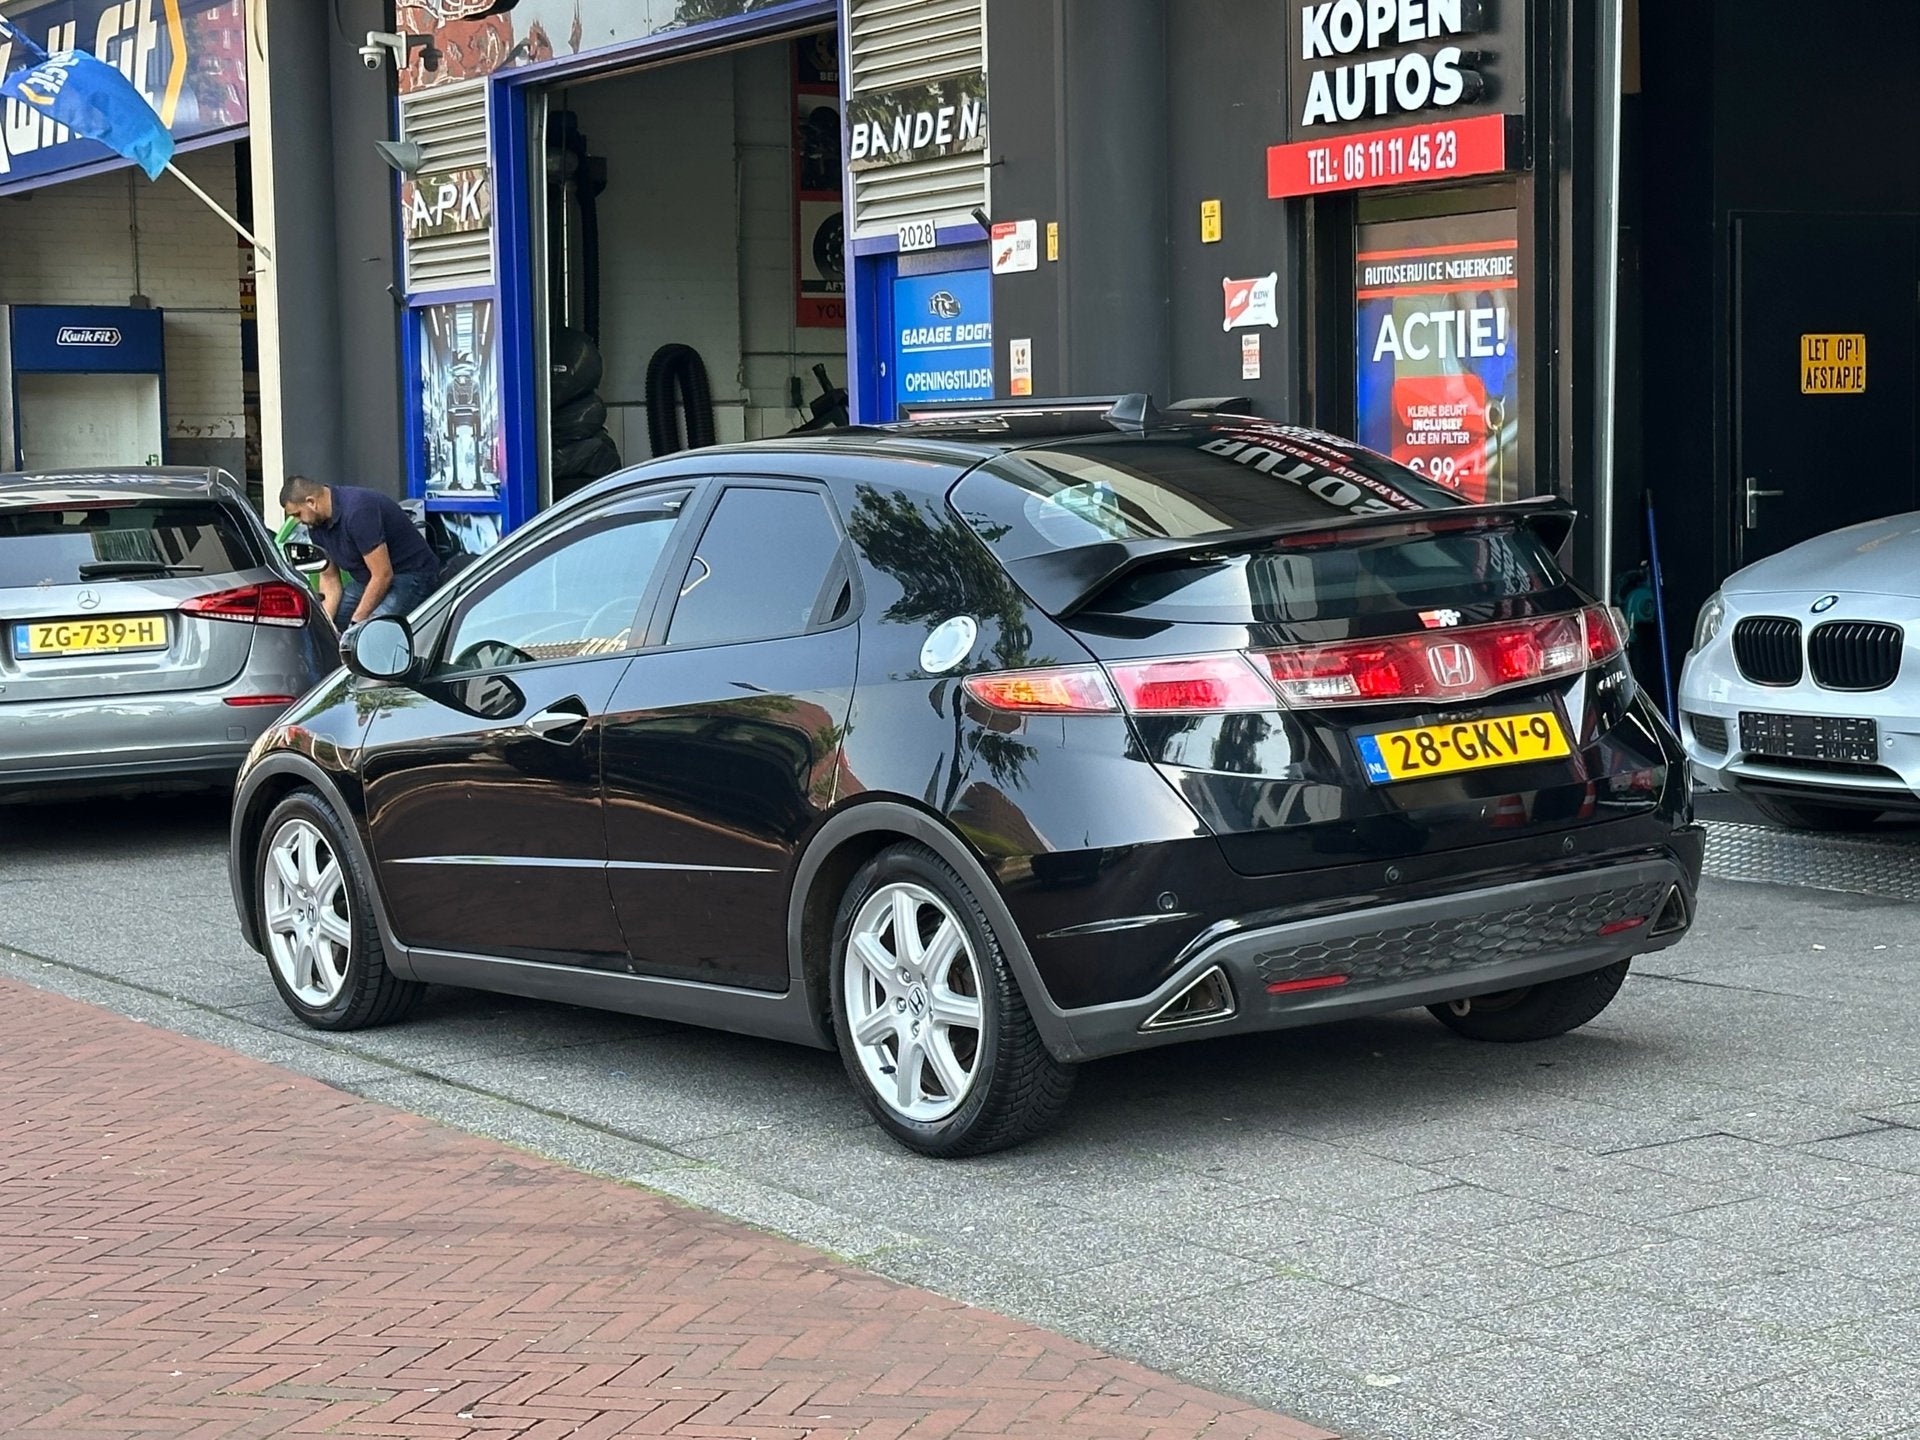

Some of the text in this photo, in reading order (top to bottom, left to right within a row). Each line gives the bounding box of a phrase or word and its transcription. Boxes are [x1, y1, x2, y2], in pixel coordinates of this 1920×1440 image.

[1302, 0, 1462, 60] KOPEN
[1302, 47, 1463, 126] AUTOS
[851, 101, 981, 160] BANDEN
[1308, 130, 1457, 185] TEL: 06 11 11 45 23
[412, 175, 485, 229] APK
[900, 223, 933, 248] 2028
[1445, 256, 1514, 280] NEHERKADE
[901, 326, 953, 346] GARAGE
[1372, 308, 1506, 362] ACTIE!
[1808, 338, 1829, 361] LET
[1806, 366, 1863, 389] AFSTAPJE
[1407, 404, 1468, 417] KLEINE BEURT
[1413, 418, 1463, 431] INCLUSIEF
[1406, 431, 1470, 445] OLIE EN FILTER
[39, 621, 154, 648] ZG-739-H
[1370, 716, 1551, 775] NL 28-GKV-9
